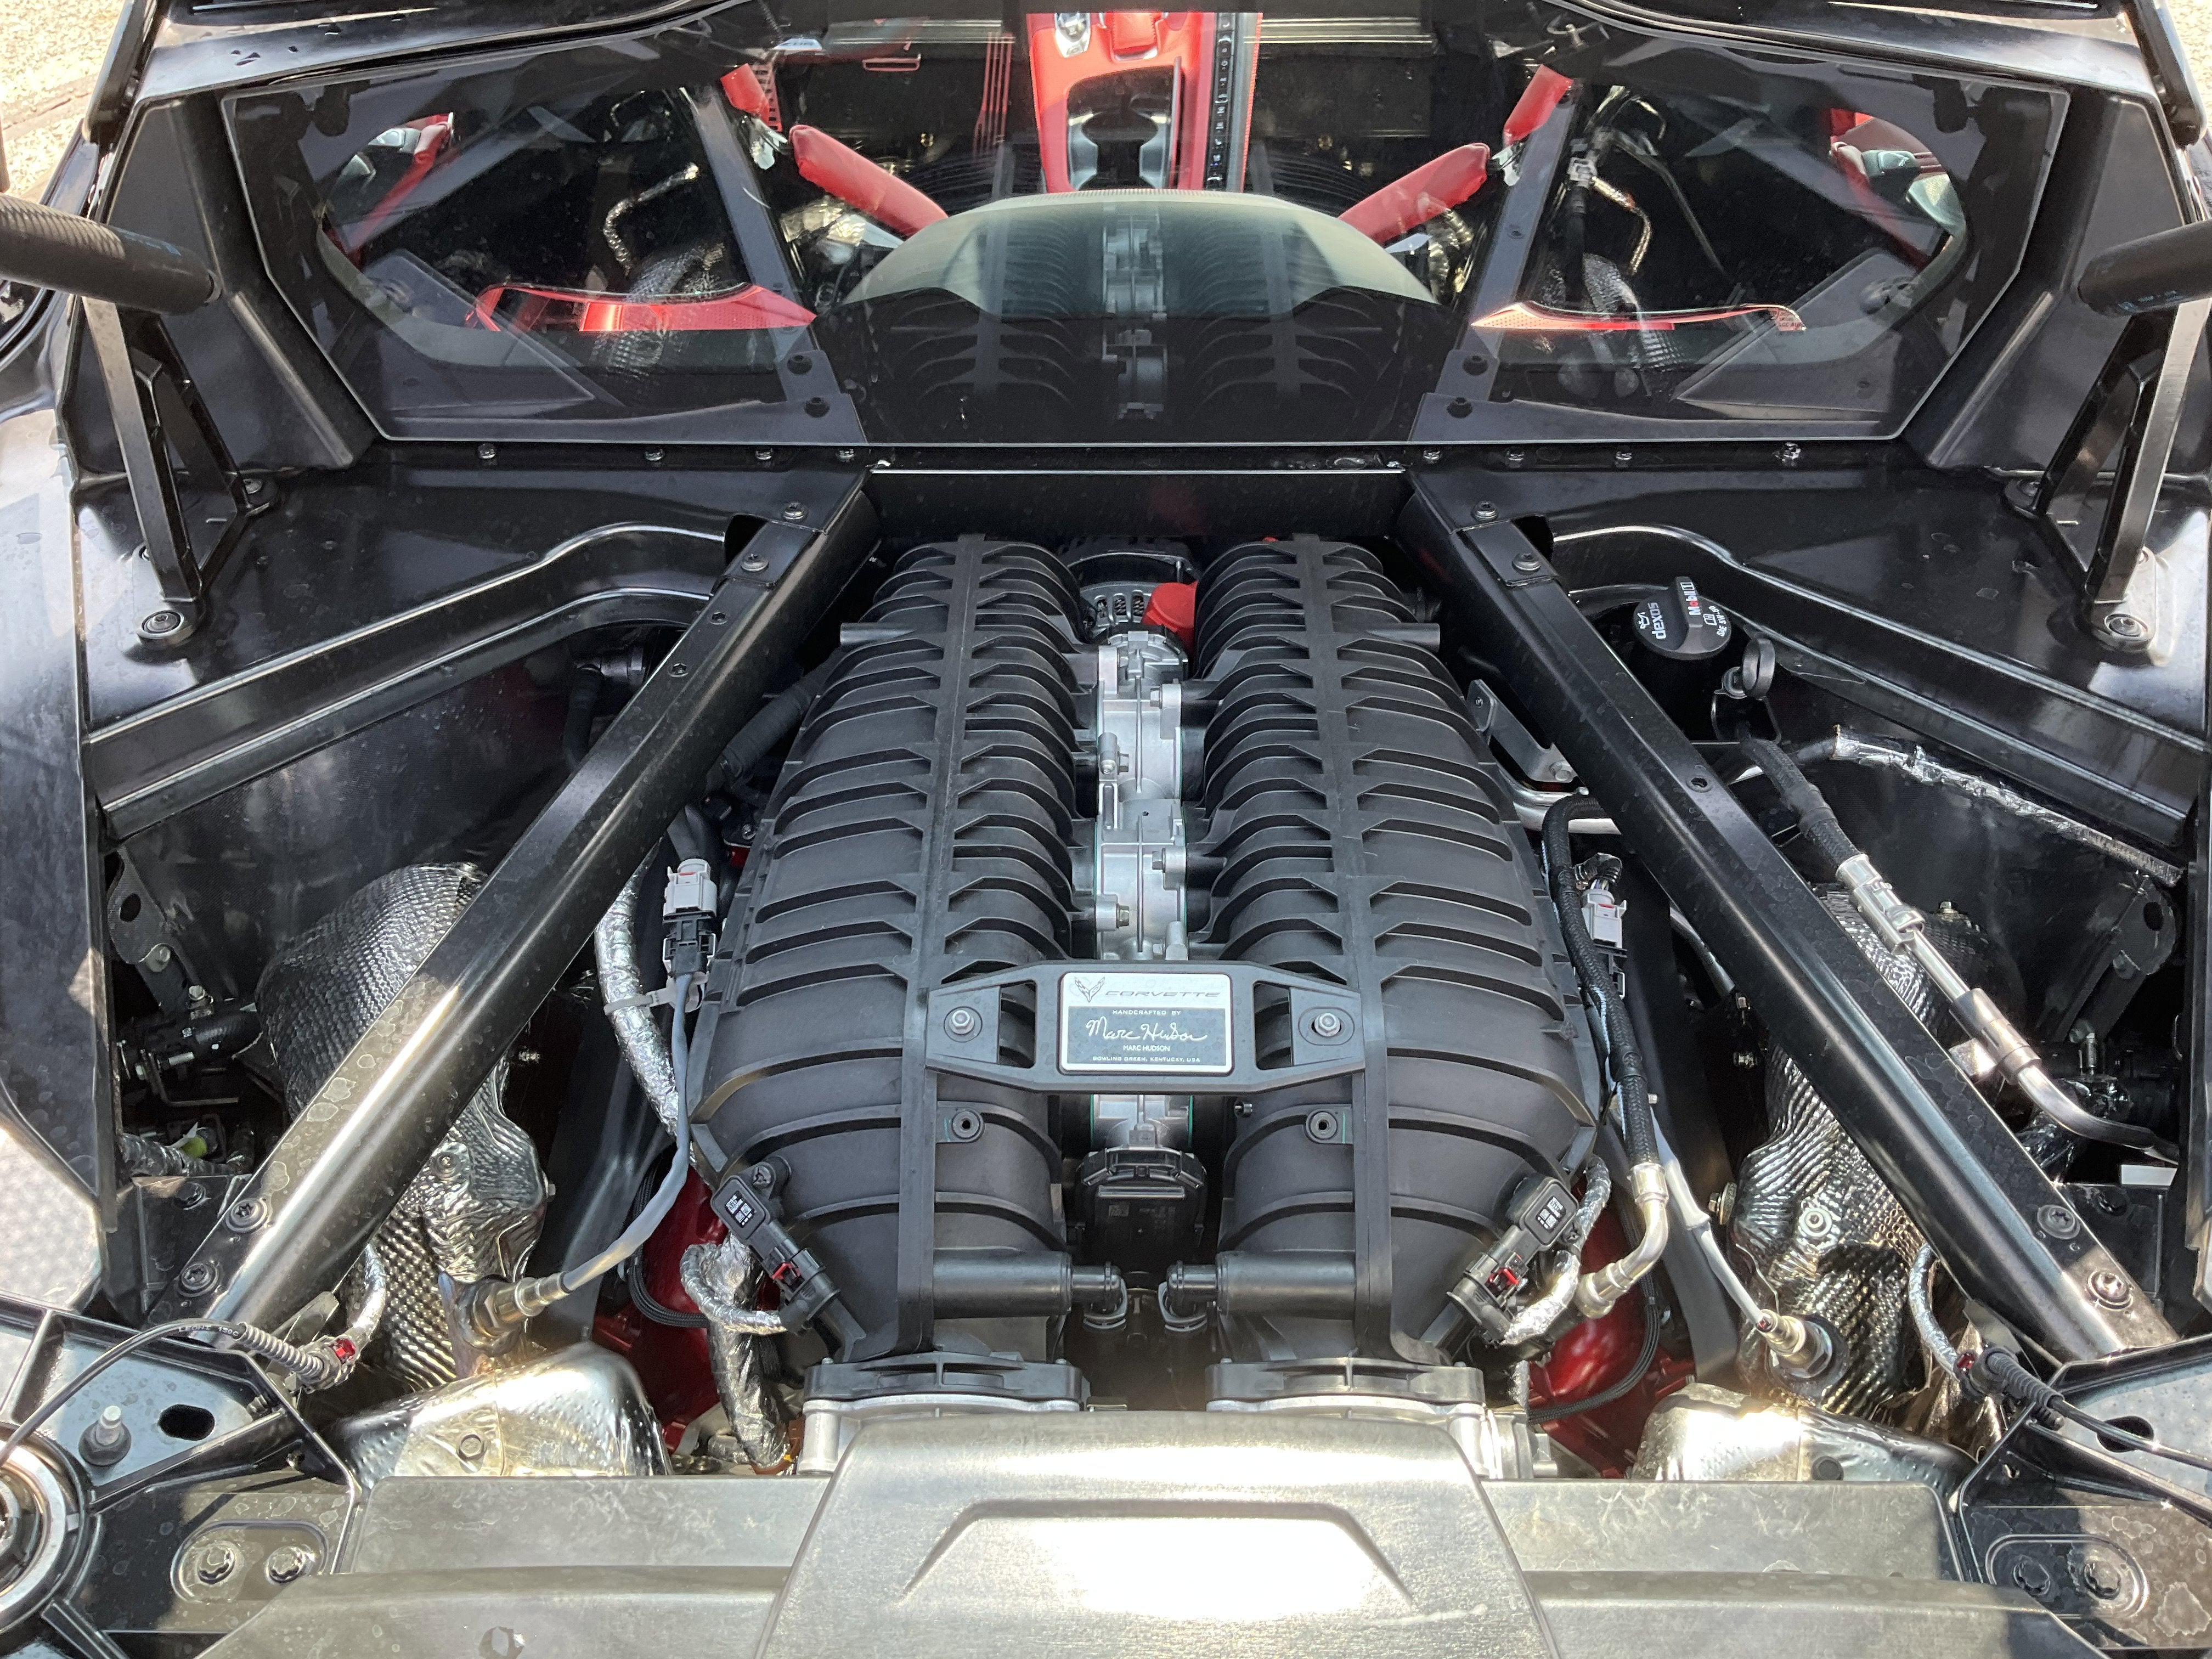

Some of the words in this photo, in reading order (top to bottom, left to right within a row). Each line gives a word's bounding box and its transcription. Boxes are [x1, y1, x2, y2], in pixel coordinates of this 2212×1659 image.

[1683, 591, 1701, 615] Mobil
[1647, 602, 1667, 639] dexos
[1716, 625, 1727, 637] SAE
[1086, 1015, 1141, 1040] Marc
